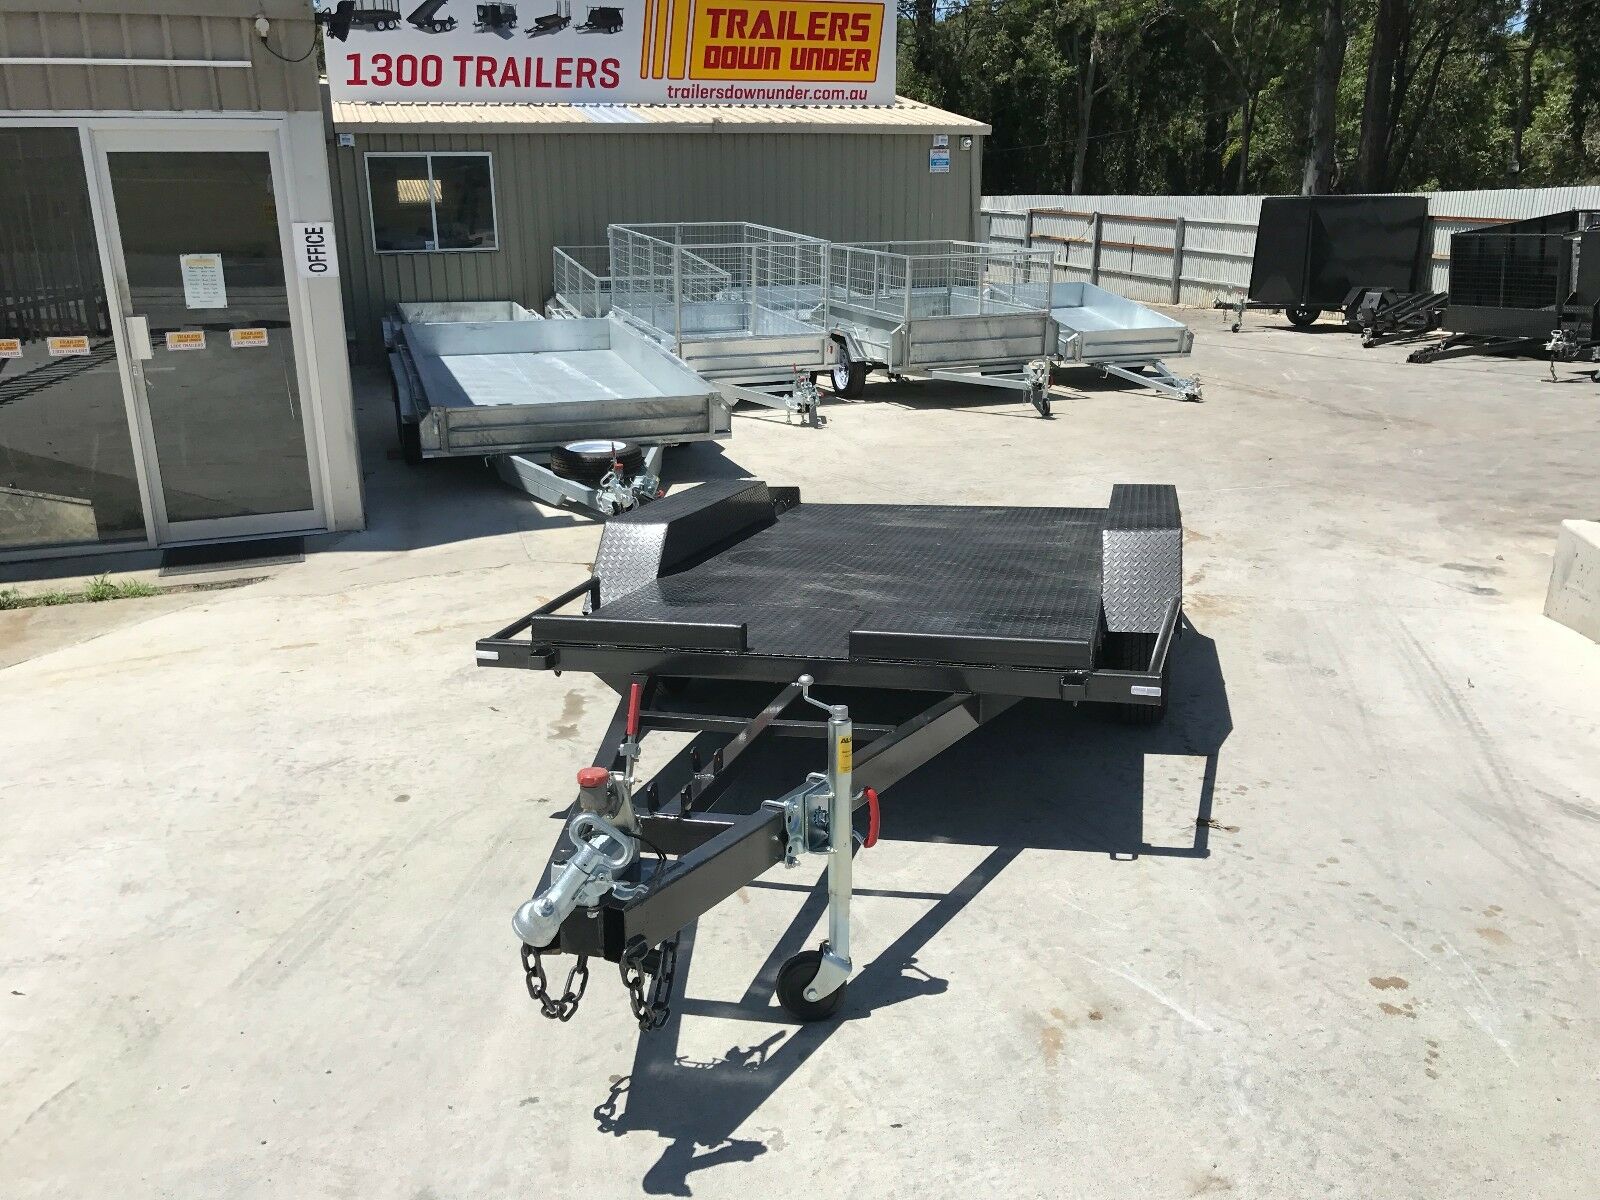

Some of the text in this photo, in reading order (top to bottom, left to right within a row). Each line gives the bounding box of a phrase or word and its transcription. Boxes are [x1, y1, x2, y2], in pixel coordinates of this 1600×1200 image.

[706, 8, 872, 42] TRAILERS
[346, 53, 621, 89] 1300 TRAILERS
[703, 45, 872, 71] DOWN UNDER
[667, 84, 868, 101] trailersdownunder.com.au
[304, 227, 328, 273] OFFICE
